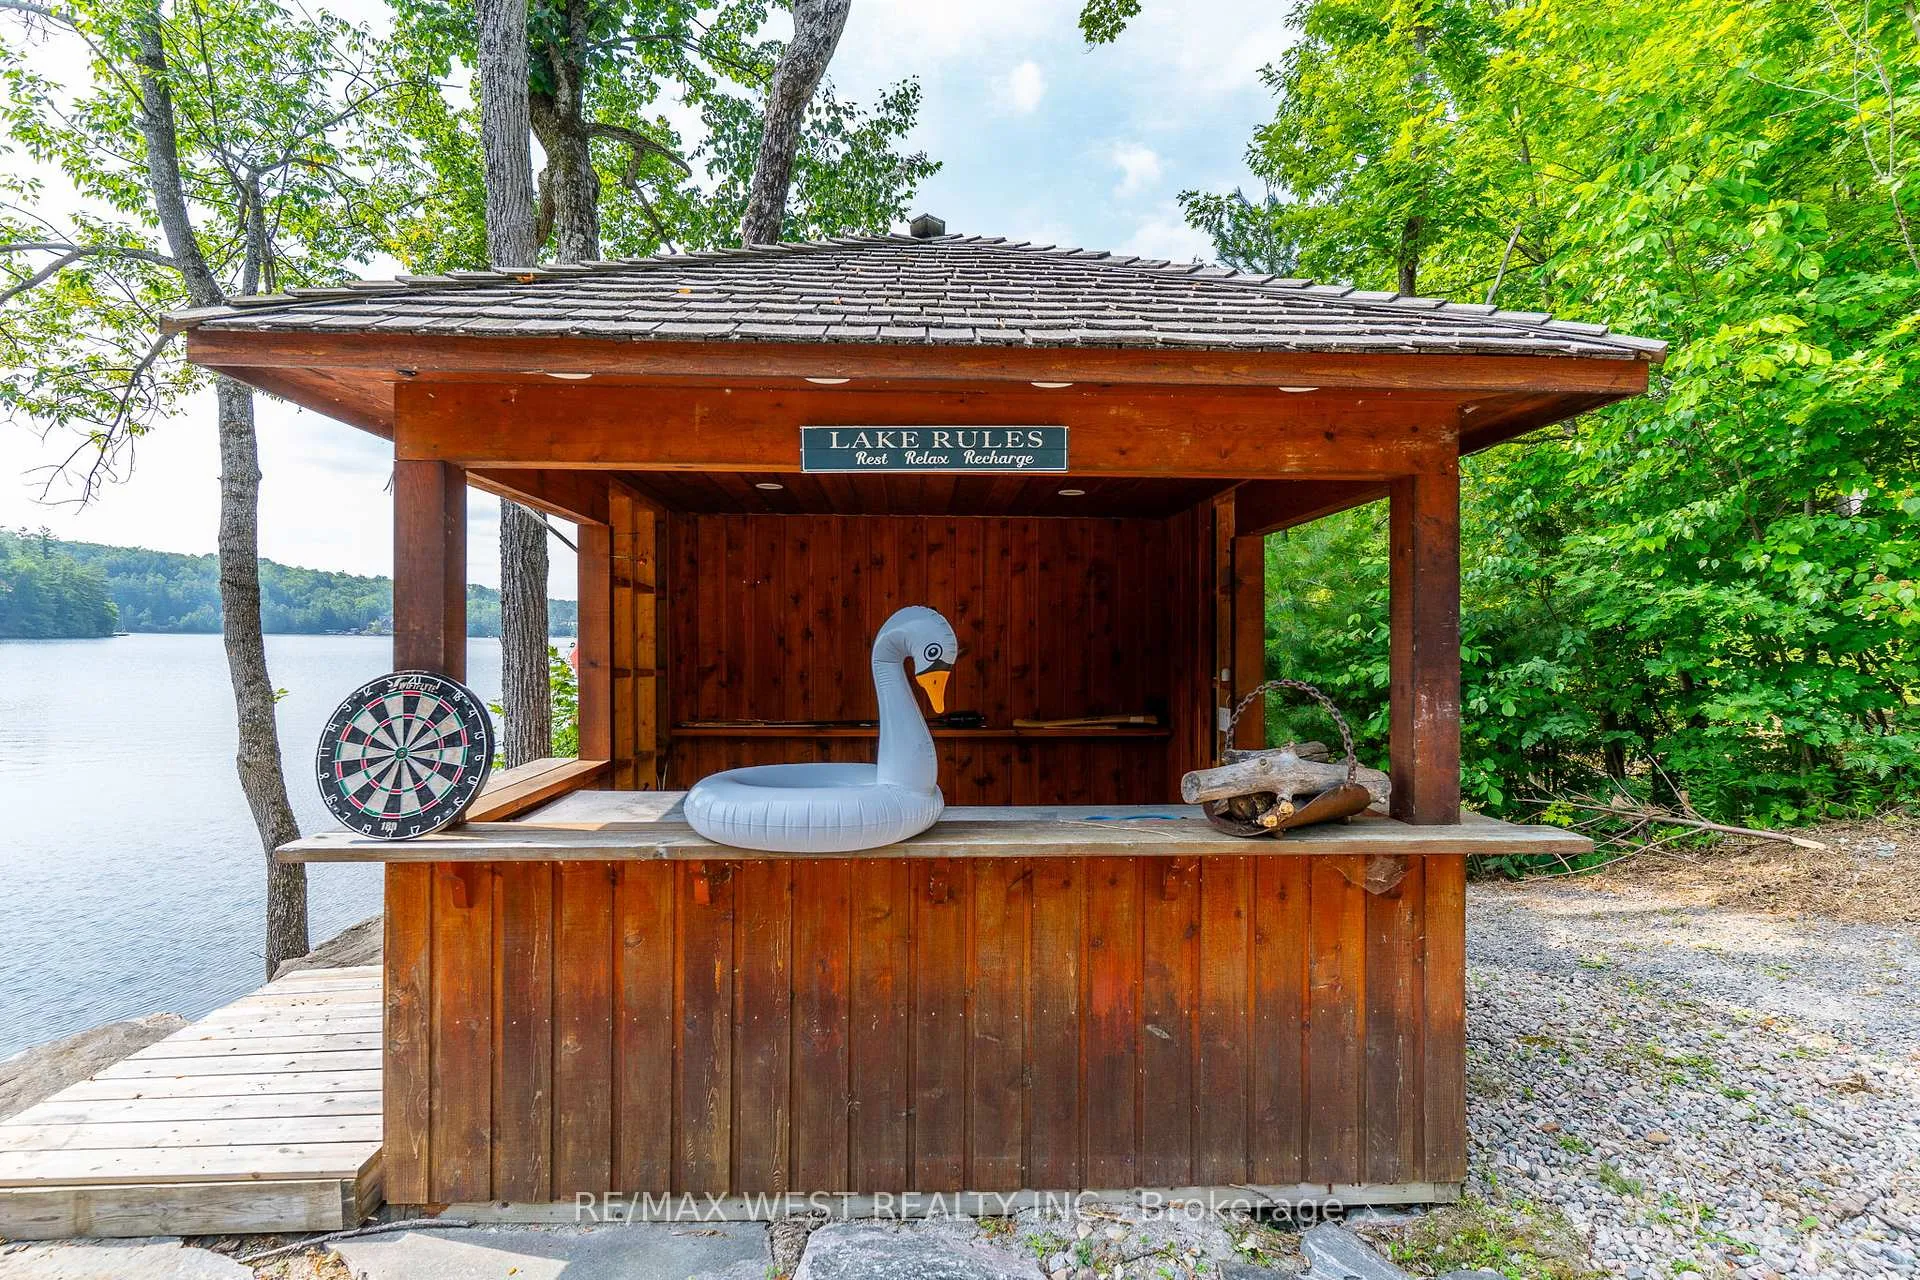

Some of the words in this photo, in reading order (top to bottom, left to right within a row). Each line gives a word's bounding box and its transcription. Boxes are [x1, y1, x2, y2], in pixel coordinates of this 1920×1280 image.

[829, 431, 920, 449] LAKE
[932, 430, 1043, 449] RULES
[855, 450, 889, 465] Rest
[904, 450, 950, 465] Relax
[963, 449, 1035, 468] Recharge
[468, 709, 477, 719] 4
[319, 772, 330, 780] 8
